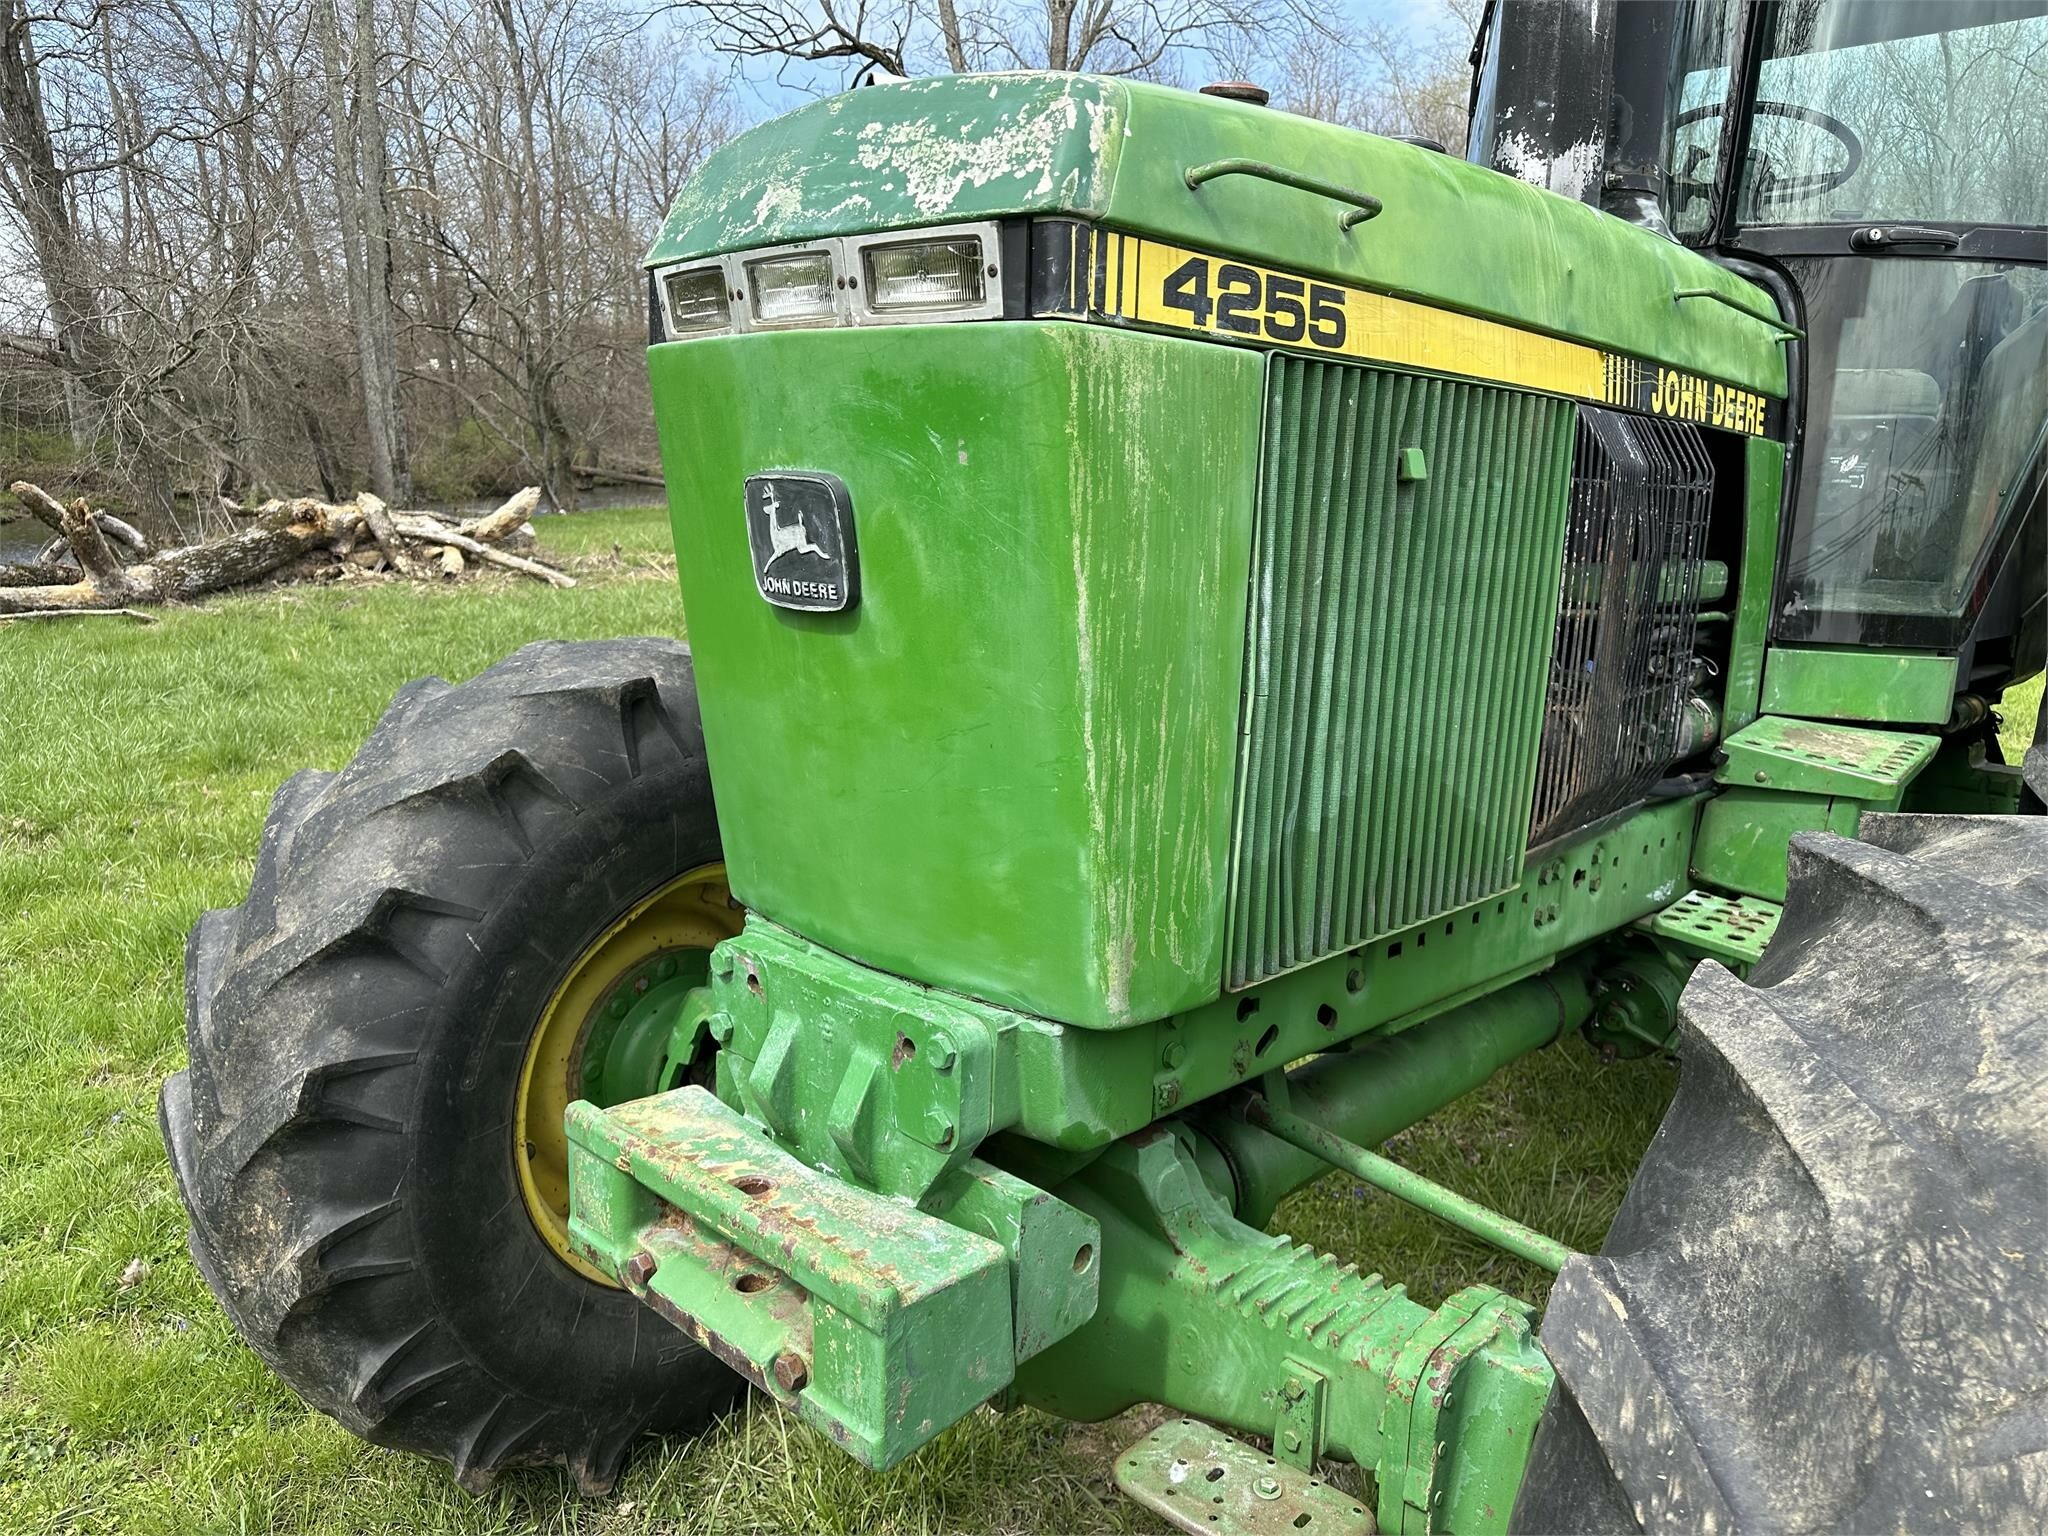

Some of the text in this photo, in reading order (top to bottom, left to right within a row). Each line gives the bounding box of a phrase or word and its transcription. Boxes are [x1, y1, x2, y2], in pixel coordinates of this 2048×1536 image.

[1162, 256, 1347, 349] 4255
[1651, 367, 1766, 436] JOHN DEERE
[762, 575, 838, 600] JOHN DEERE
